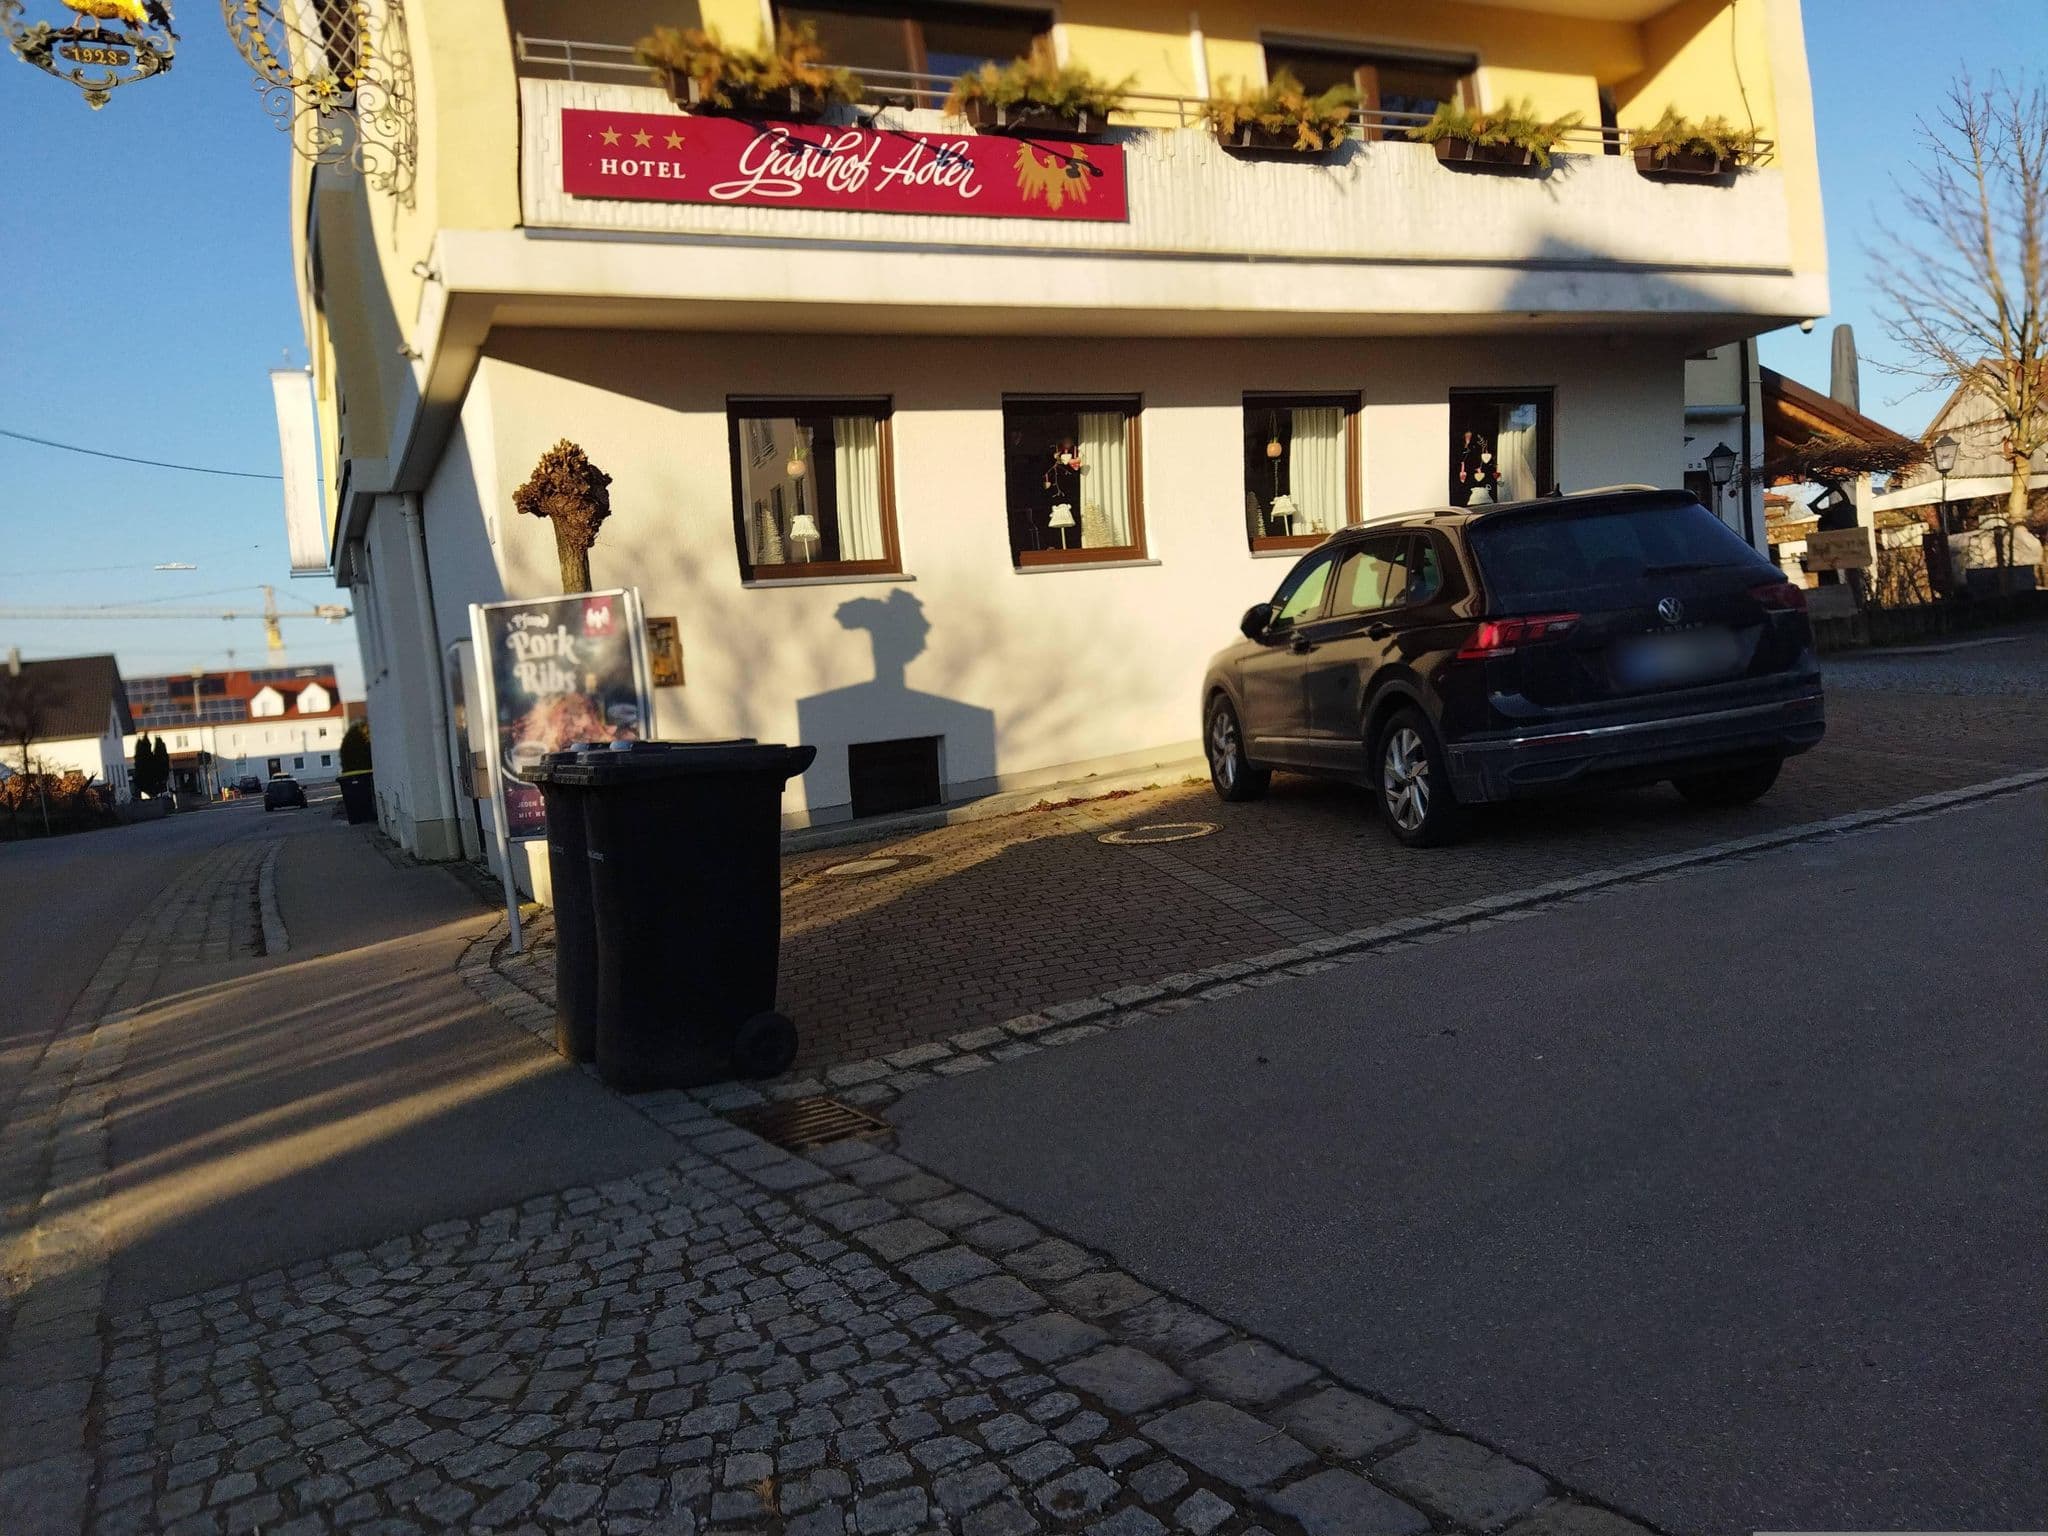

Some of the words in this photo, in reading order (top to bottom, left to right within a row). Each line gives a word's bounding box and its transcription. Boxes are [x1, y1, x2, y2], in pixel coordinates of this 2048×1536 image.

[600, 157, 686, 180] HOTEL
[708, 127, 881, 200] Gasthof
[873, 137, 983, 199] Adler
[506, 625, 581, 665] Pork
[513, 660, 577, 697] Ribs
